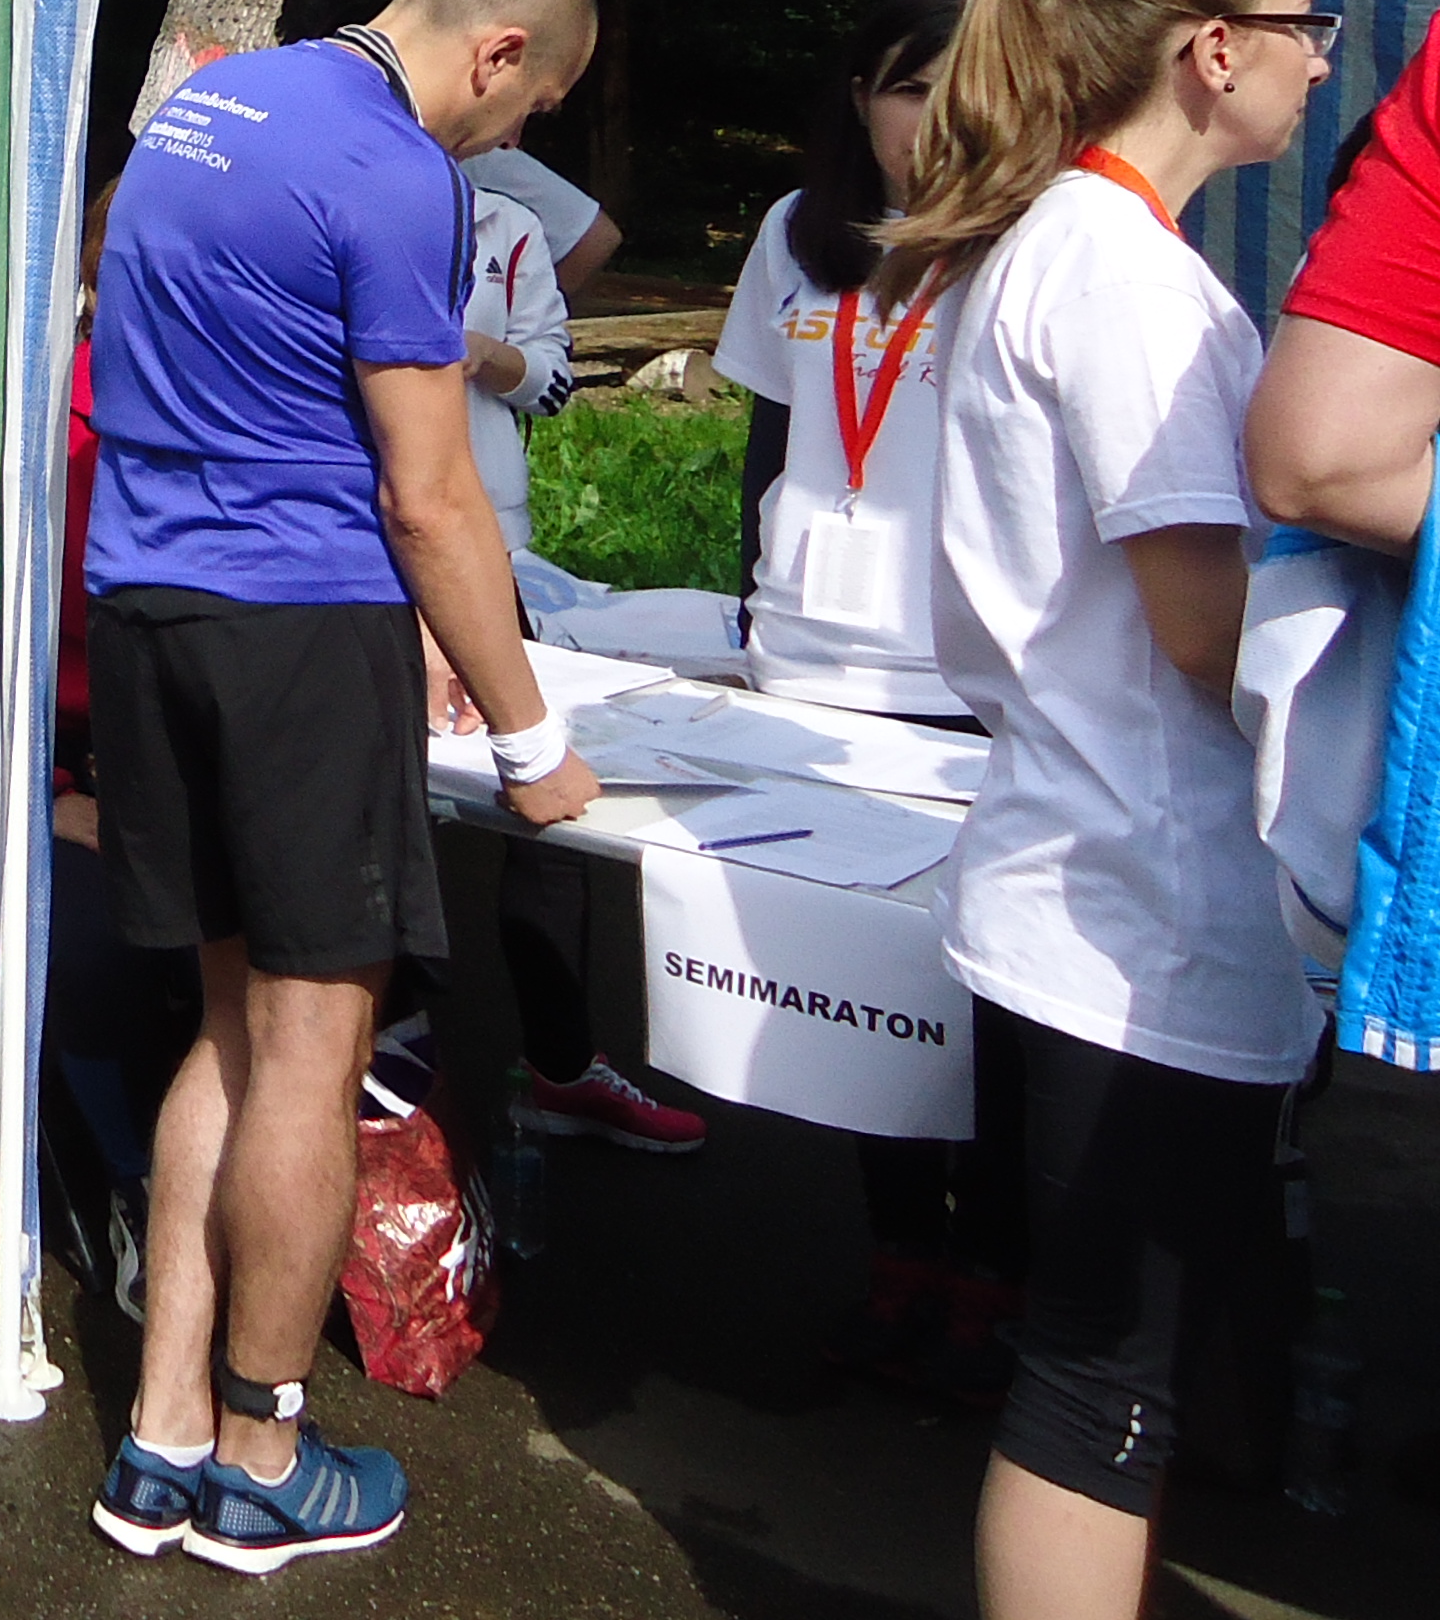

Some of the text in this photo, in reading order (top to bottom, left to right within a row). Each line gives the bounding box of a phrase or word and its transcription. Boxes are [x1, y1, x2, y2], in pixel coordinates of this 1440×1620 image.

[163, 138, 233, 173] MARATHON
[187, 128, 216, 149] 2015
[663, 950, 947, 1047] SEMIMARATON
